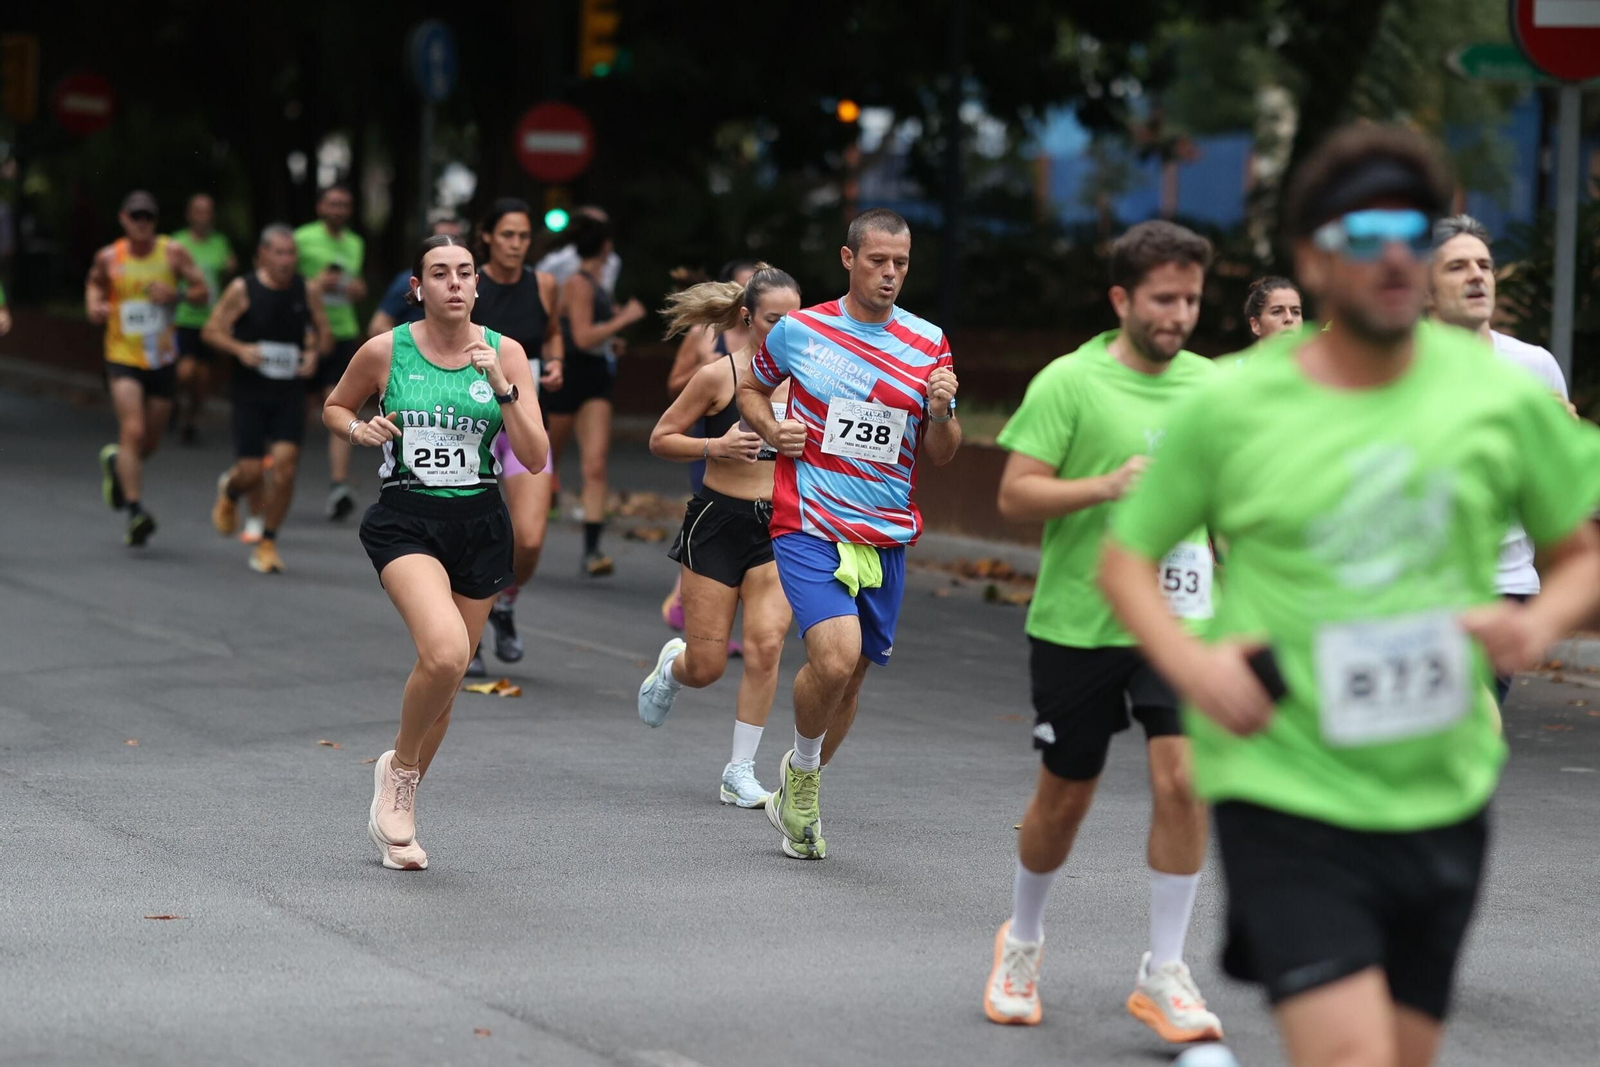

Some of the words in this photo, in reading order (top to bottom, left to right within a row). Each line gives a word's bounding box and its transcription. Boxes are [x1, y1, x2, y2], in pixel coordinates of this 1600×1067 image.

[824, 348, 872, 385] MEDIA
[838, 418, 891, 445] 738
[414, 448, 466, 468] 251
[1158, 567, 1199, 594] 53
